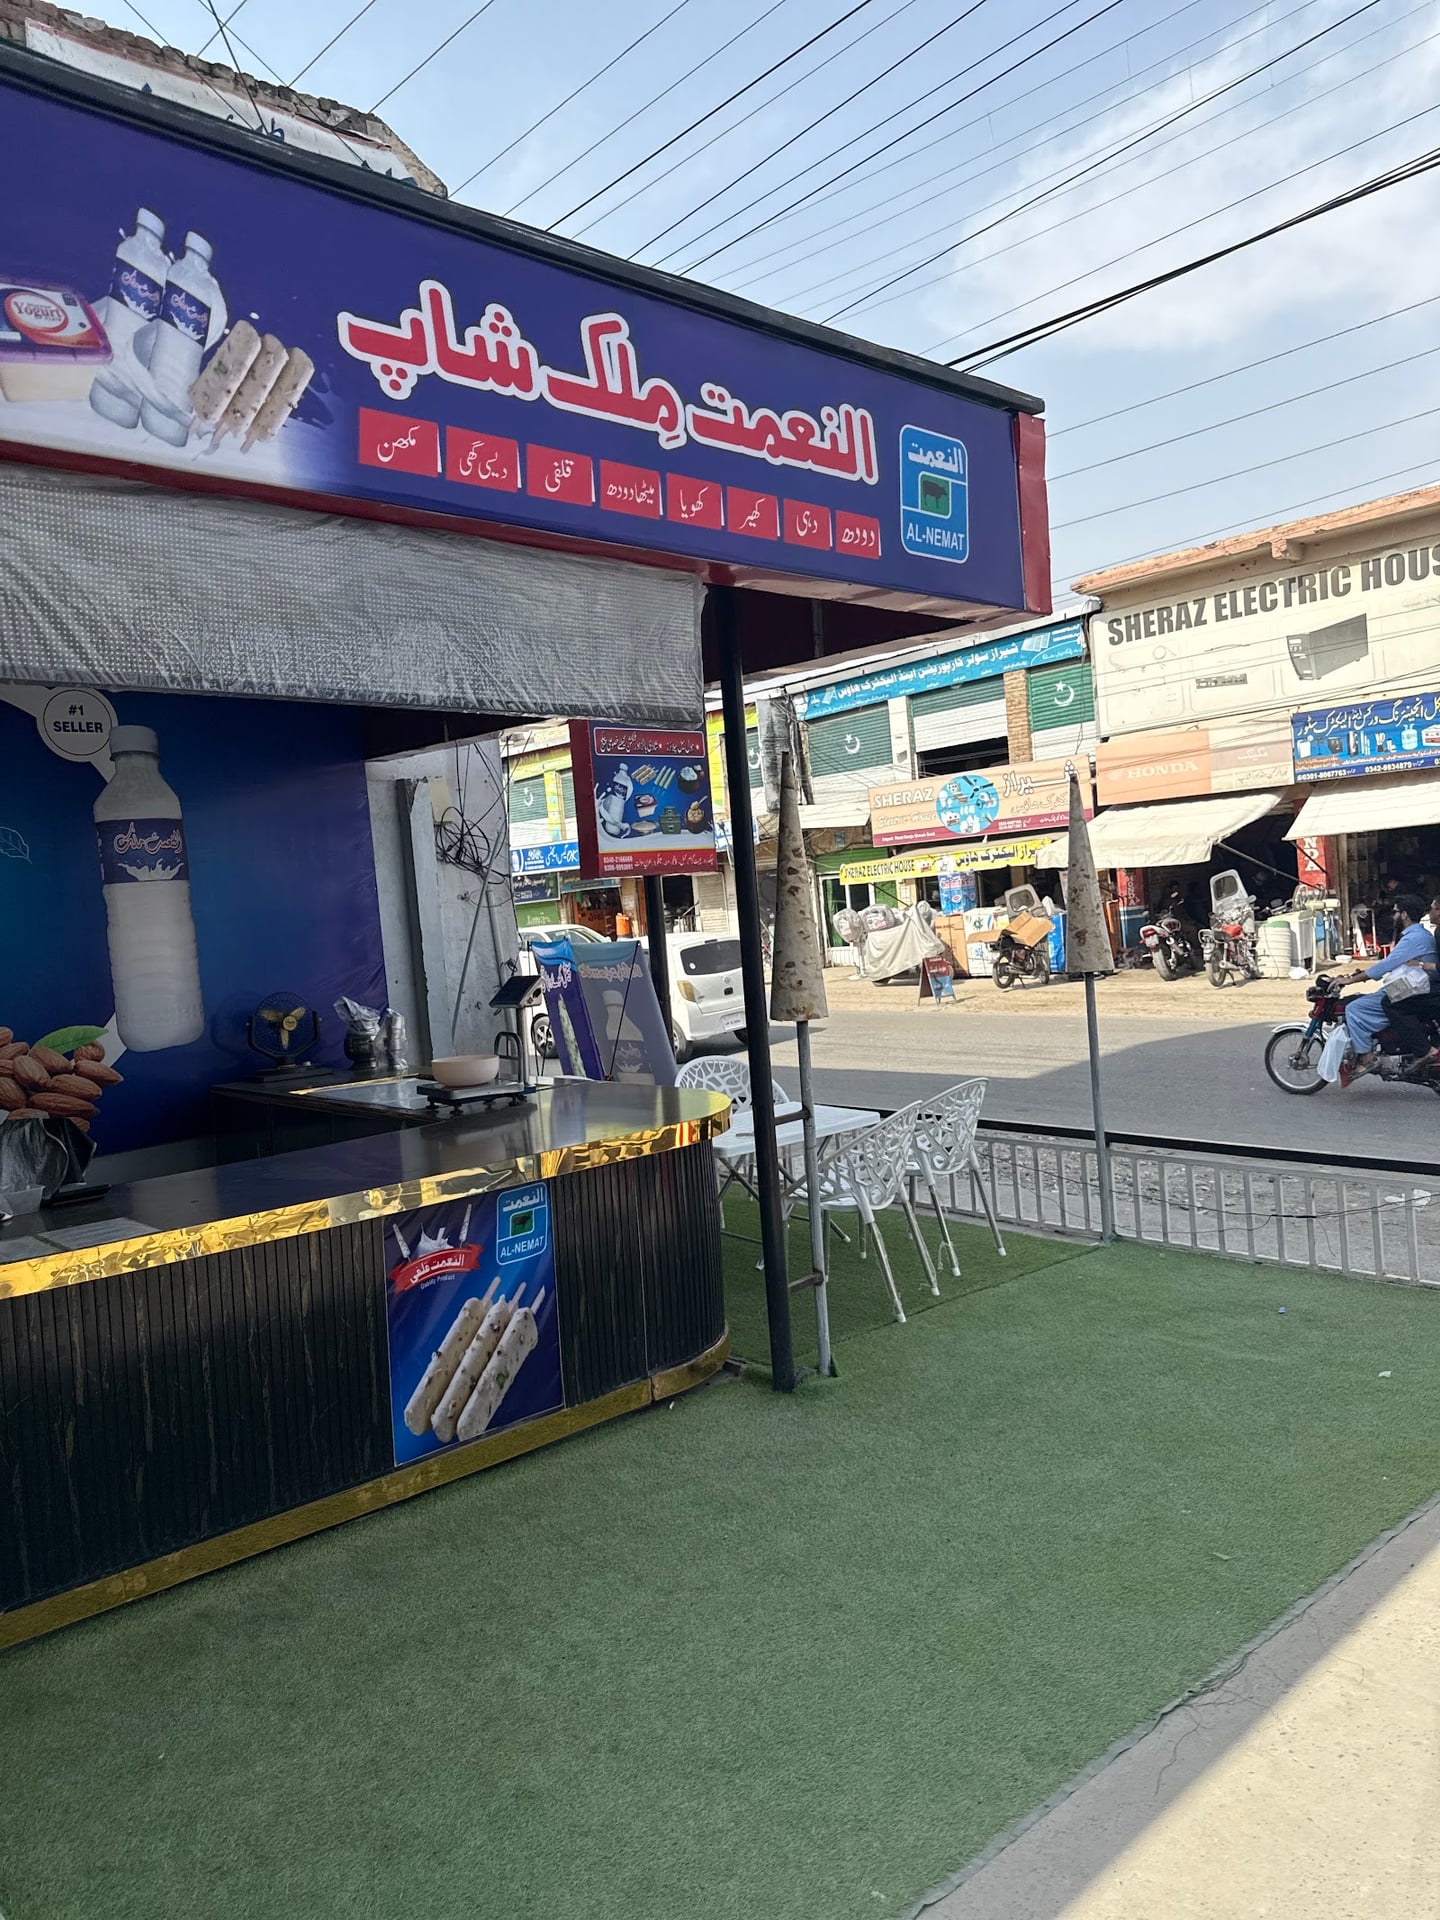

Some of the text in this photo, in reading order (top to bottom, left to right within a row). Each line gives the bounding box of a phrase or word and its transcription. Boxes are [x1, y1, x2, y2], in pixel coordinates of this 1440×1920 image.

[13, 301, 62, 319] Yogurt
[337, 279, 541, 401] شاپ
[377, 425, 421, 463] مکھن
[686, 382, 879, 485] النعمت
[459, 441, 508, 479] دیسی گھی
[908, 442, 964, 475] النعمت
[545, 459, 575, 493] قلفی
[606, 481, 633, 500] دودھ
[680, 486, 708, 518] کھویا
[739, 497, 766, 530] کھیر
[796, 506, 818, 537] دہی
[841, 526, 875, 547] دودھ
[906, 525, 965, 551] AL-NEMAT
[1107, 598, 1208, 646] SHERAZ
[1214, 565, 1351, 623] ELECTRIC
[68, 705, 84, 716] #1
[53, 721, 103, 734] SELLER
[1127, 761, 1199, 779] HONDA
[874, 788, 934, 809] SHERAZ
[844, 858, 915, 880] SHERAZ ELECTRIC HOUSE
[1303, 837, 1321, 872] NDA
[502, 1187, 544, 1212] النعمت
[500, 1235, 545, 1259] AL-NEMAT
[410, 1253, 465, 1284] النعمت قلفی
